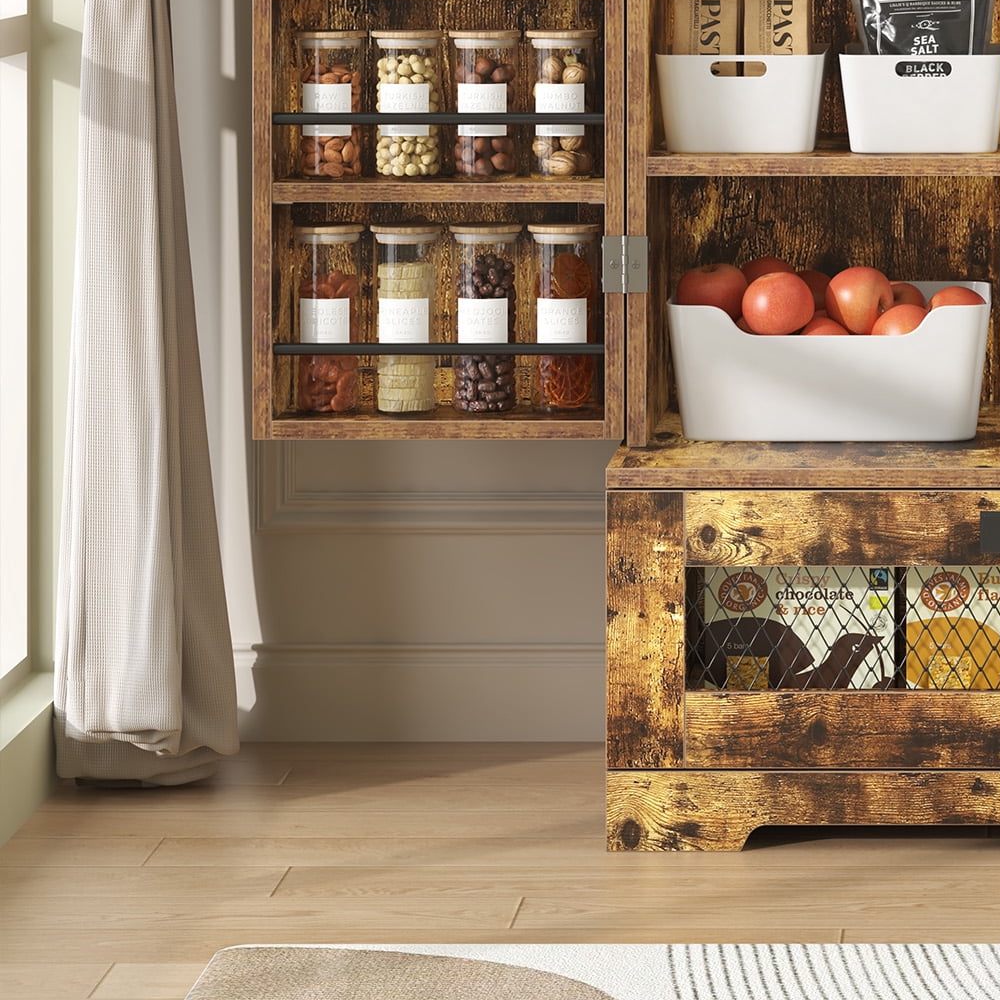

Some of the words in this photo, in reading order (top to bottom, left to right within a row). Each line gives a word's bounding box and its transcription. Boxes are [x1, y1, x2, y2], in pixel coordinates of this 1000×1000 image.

[913, 34, 936, 46] SEA
[910, 44, 939, 56] SALT
[905, 62, 944, 73] BLACK
[775, 572, 831, 587] Crispy
[775, 588, 854, 601] chocolate
[775, 604, 789, 616] &
[793, 605, 825, 616] rice
